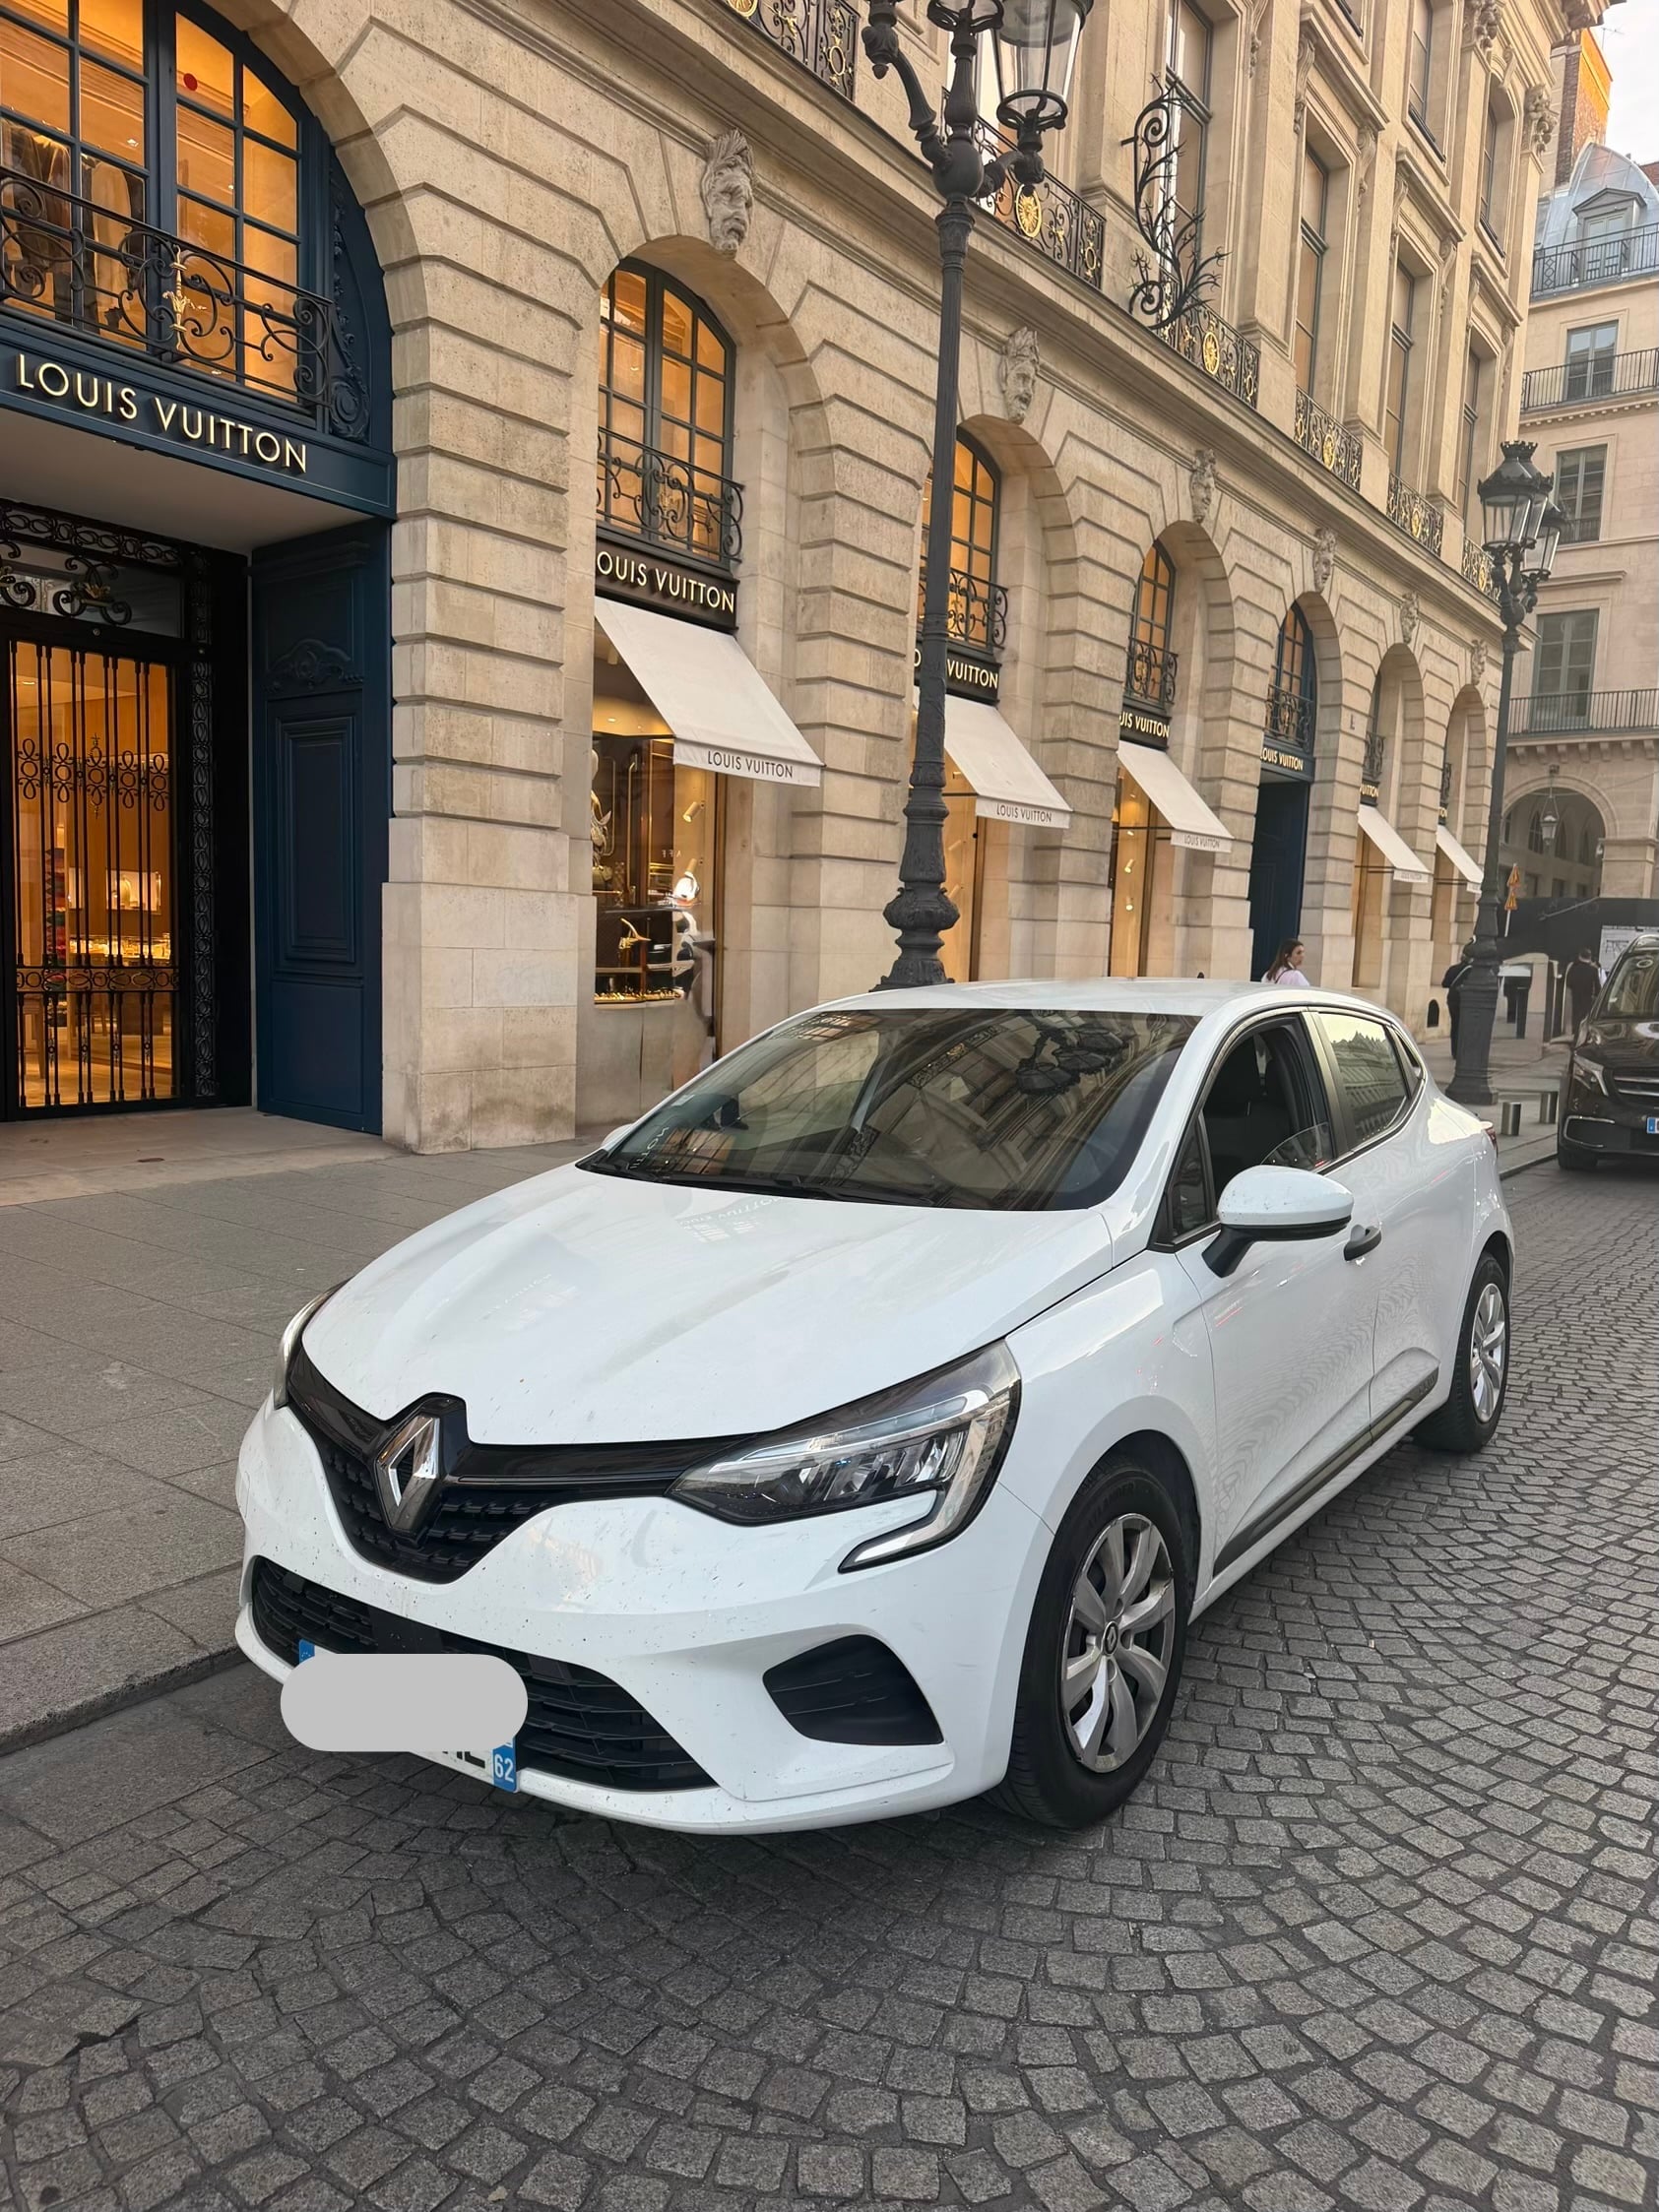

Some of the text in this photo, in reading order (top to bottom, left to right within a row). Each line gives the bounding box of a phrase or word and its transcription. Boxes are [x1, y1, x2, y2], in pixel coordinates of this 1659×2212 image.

[16, 352, 307, 474] LOUIS VUITTON
[597, 550, 734, 613] OUIS VUITTON
[946, 658, 998, 690] VUITTON
[1119, 711, 1170, 738] UIS VUITTON
[707, 750, 794, 779] LOUIS VUITTON
[1260, 747, 1305, 772] OUIS VUITTON
[996, 802, 1053, 823] LOUIS VUITTON
[1183, 834, 1220, 850] LOUIS VUITTON
[494, 1753, 515, 1783] 62
